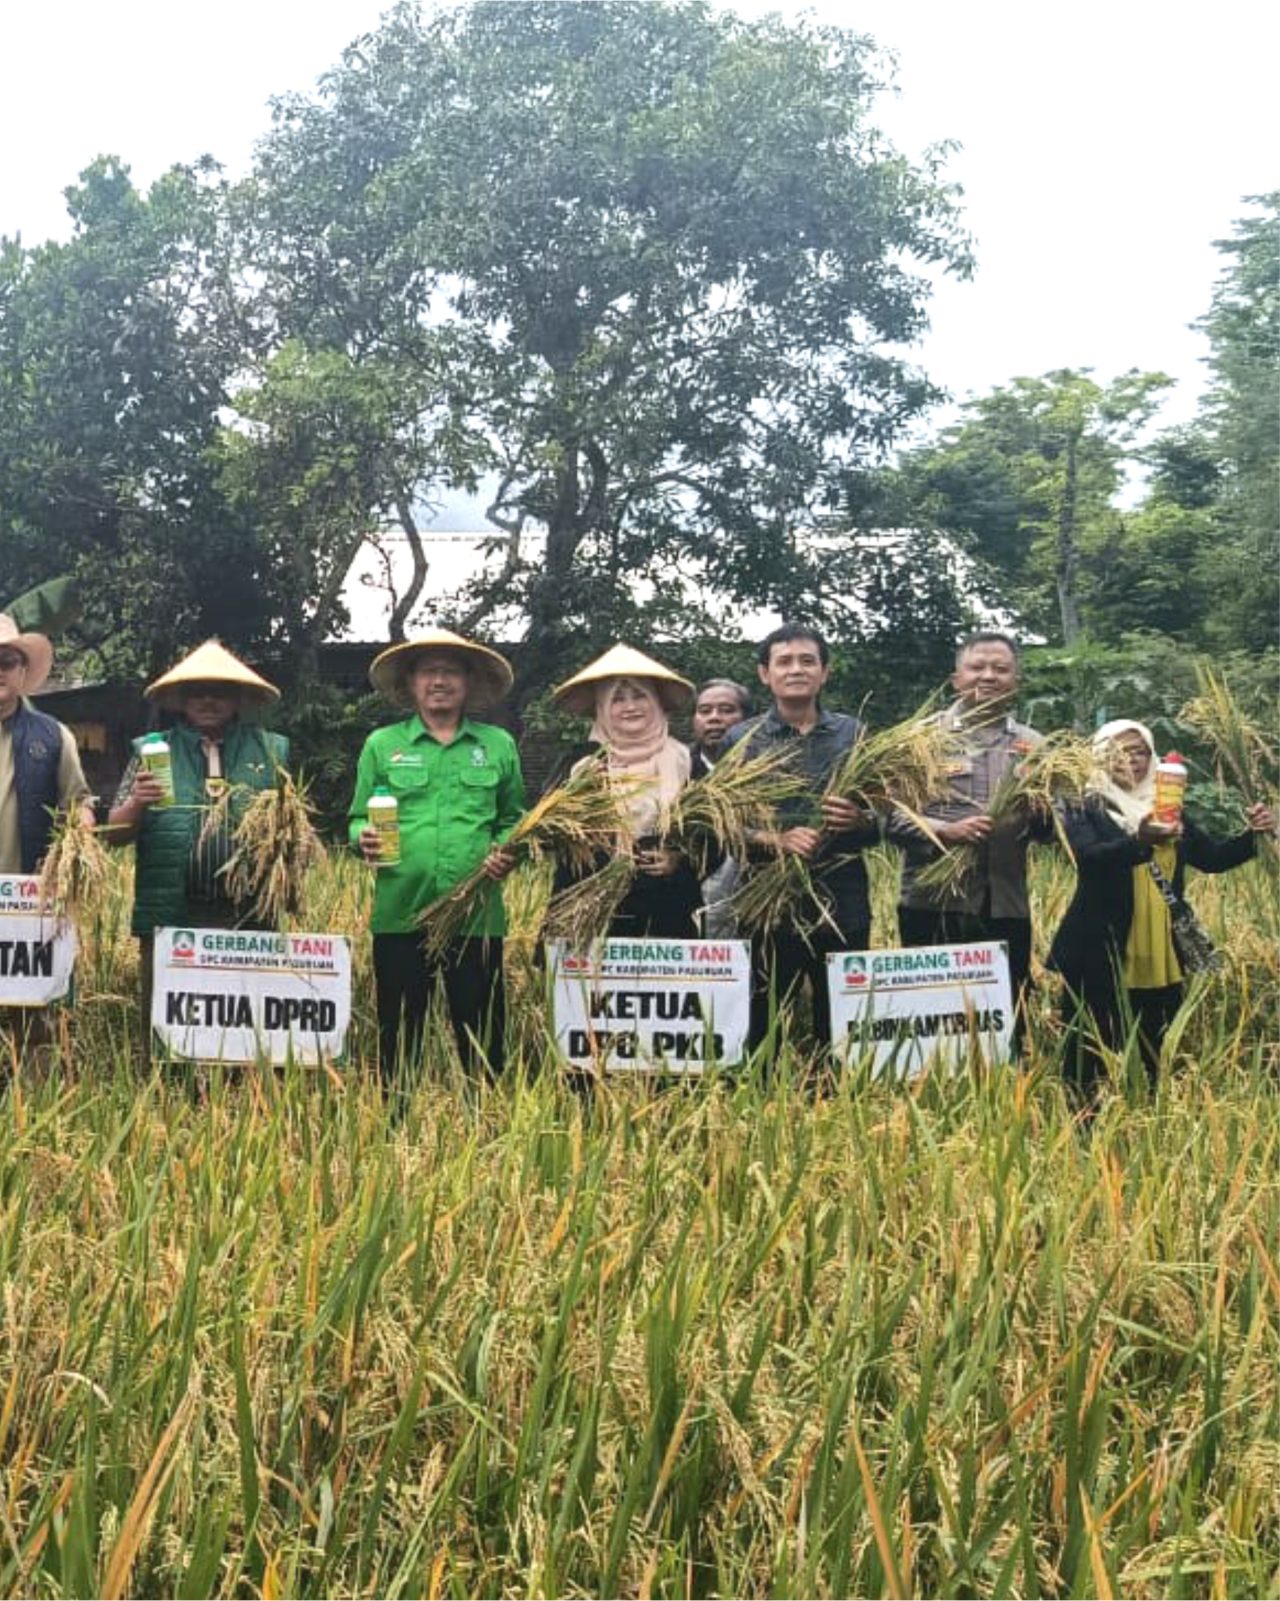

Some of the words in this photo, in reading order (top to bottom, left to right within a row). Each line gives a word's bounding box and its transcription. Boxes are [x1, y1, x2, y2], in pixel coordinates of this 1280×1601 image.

[18, 880, 38, 898] TA
[202, 935, 286, 953] GERBANG
[291, 938, 332, 956] TANI
[689, 945, 731, 962] TANI
[872, 952, 950, 972] GERBANG
[953, 949, 993, 967] TANI
[166, 991, 254, 1029] KETUA
[264, 996, 336, 1033] DPRD
[590, 990, 703, 1020] KETUA
